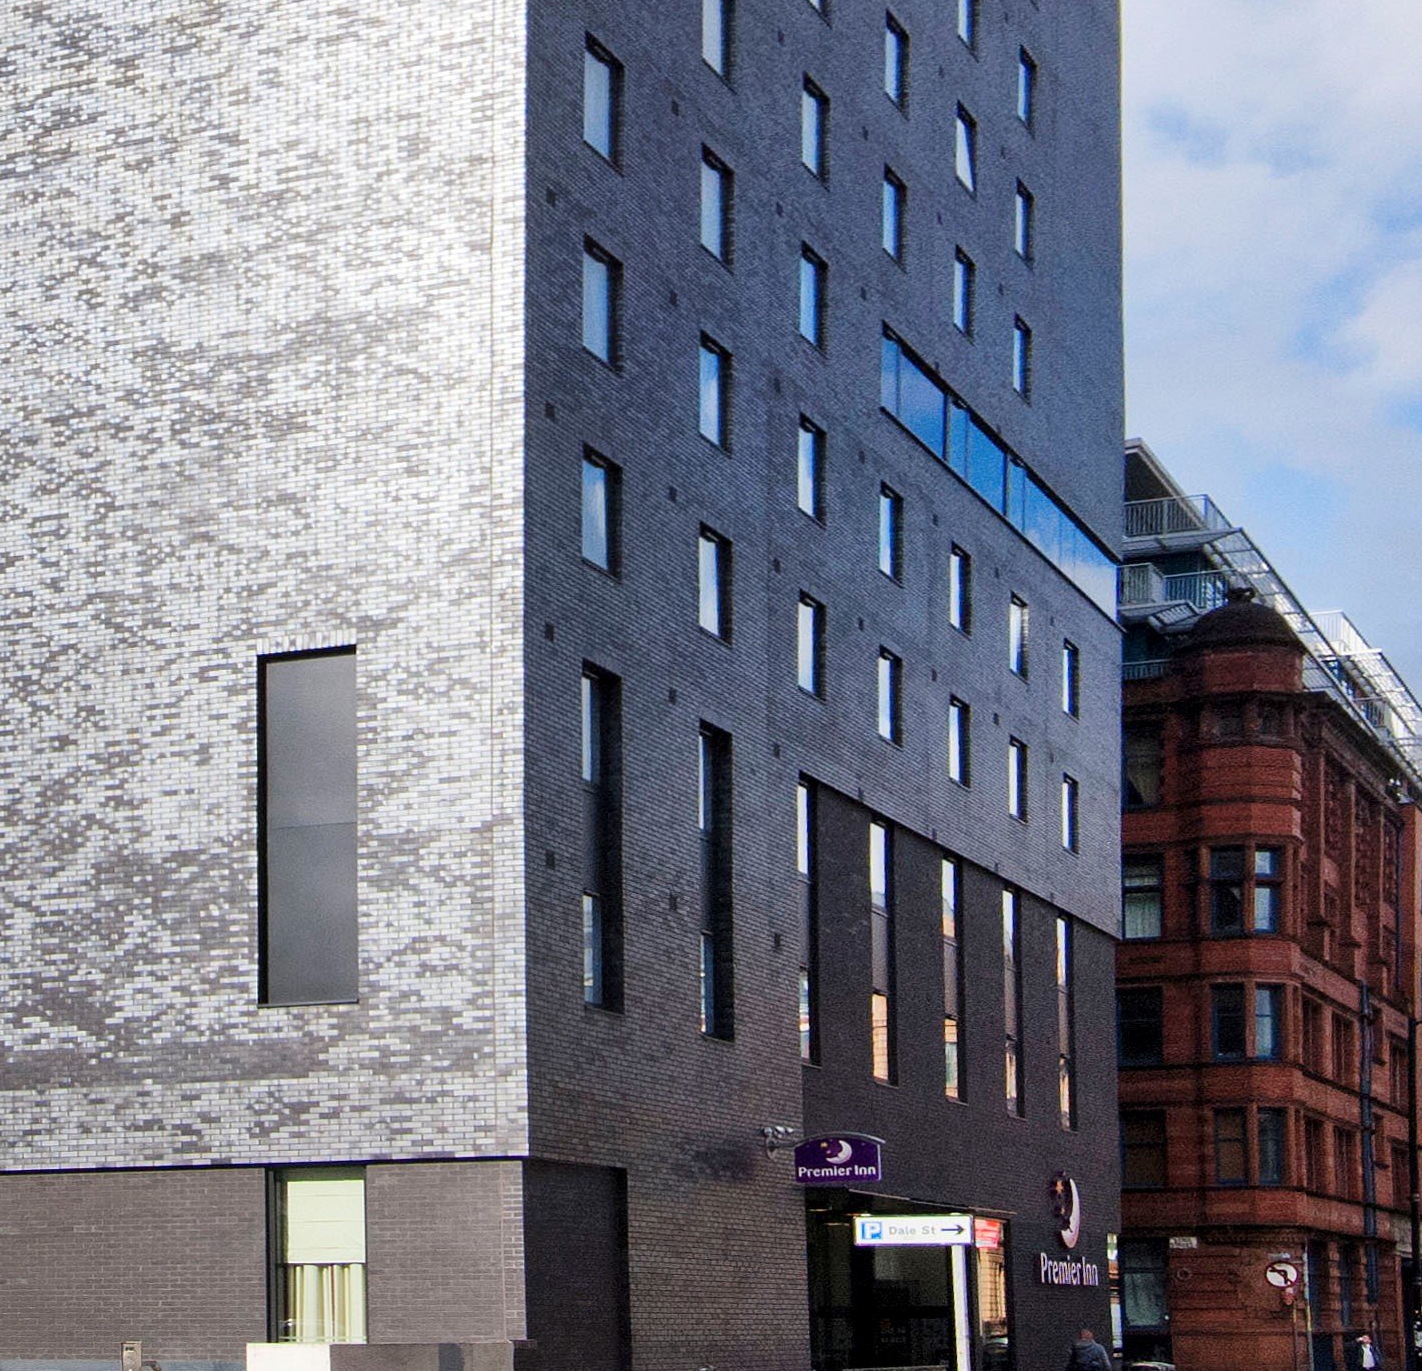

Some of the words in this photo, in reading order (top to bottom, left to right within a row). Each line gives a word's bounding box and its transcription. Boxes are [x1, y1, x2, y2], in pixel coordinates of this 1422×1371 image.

[798, 1166, 852, 1177] Premier
[854, 1165, 876, 1176] Inn
[889, 1225, 916, 1235] Dale
[922, 1225, 935, 1235] St
[1040, 1252, 1081, 1285] Premier
[1082, 1256, 1099, 1285] Inn
